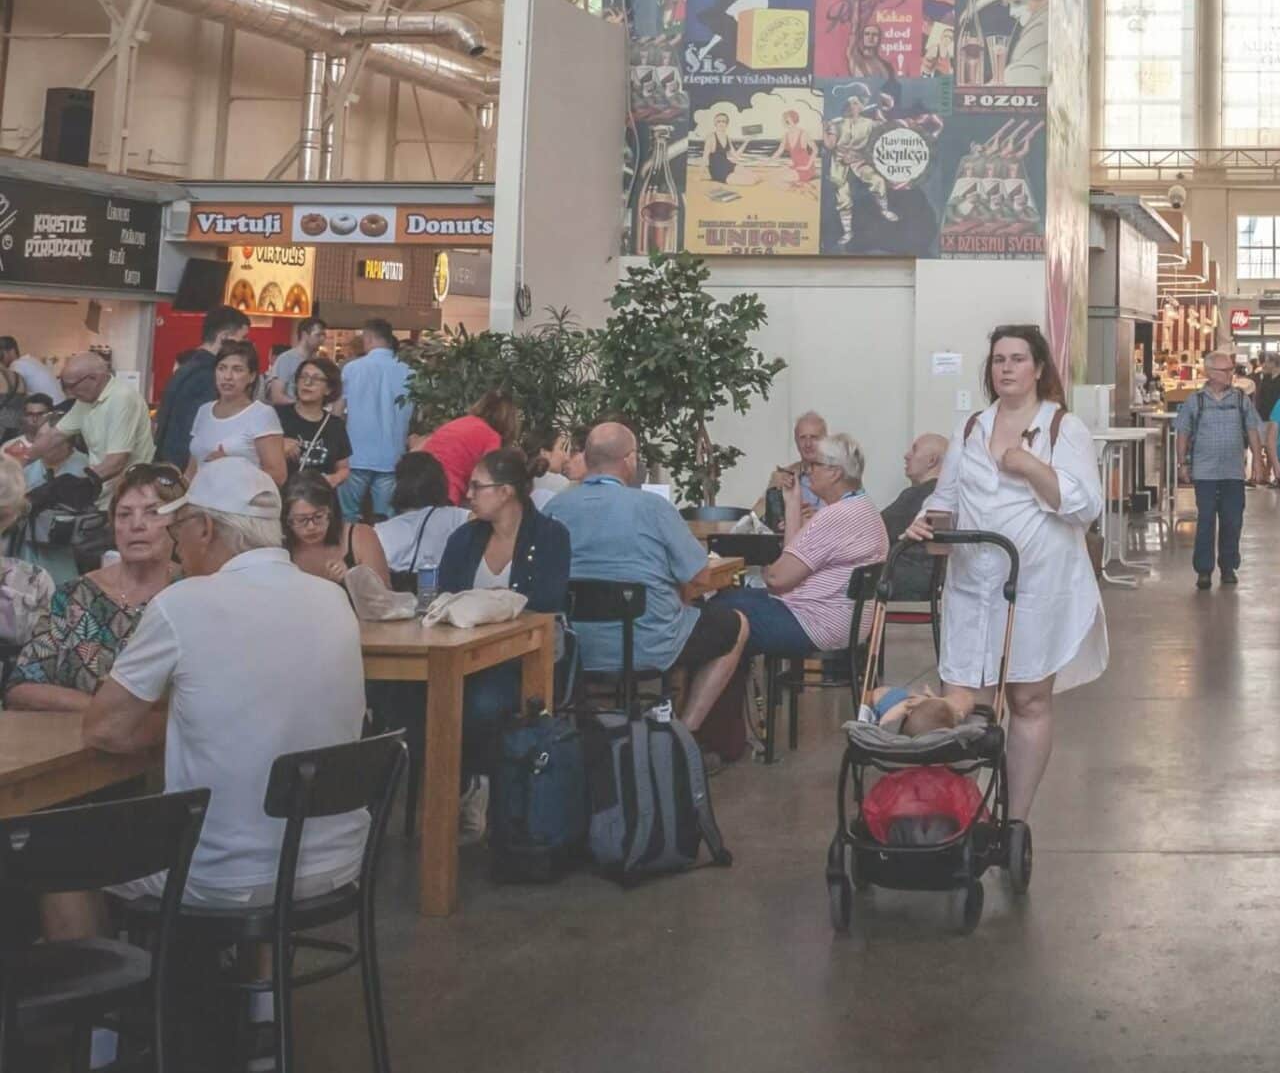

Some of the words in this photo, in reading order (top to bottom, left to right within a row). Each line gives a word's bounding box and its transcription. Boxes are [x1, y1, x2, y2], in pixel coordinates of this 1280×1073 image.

[884, 28, 911, 39] dod
[979, 94, 1040, 108] OZOL
[33, 213, 88, 233] KARSTIE
[405, 213, 494, 236] Donuts
[705, 229, 801, 247] UNION
[1231, 311, 1249, 327] illy
